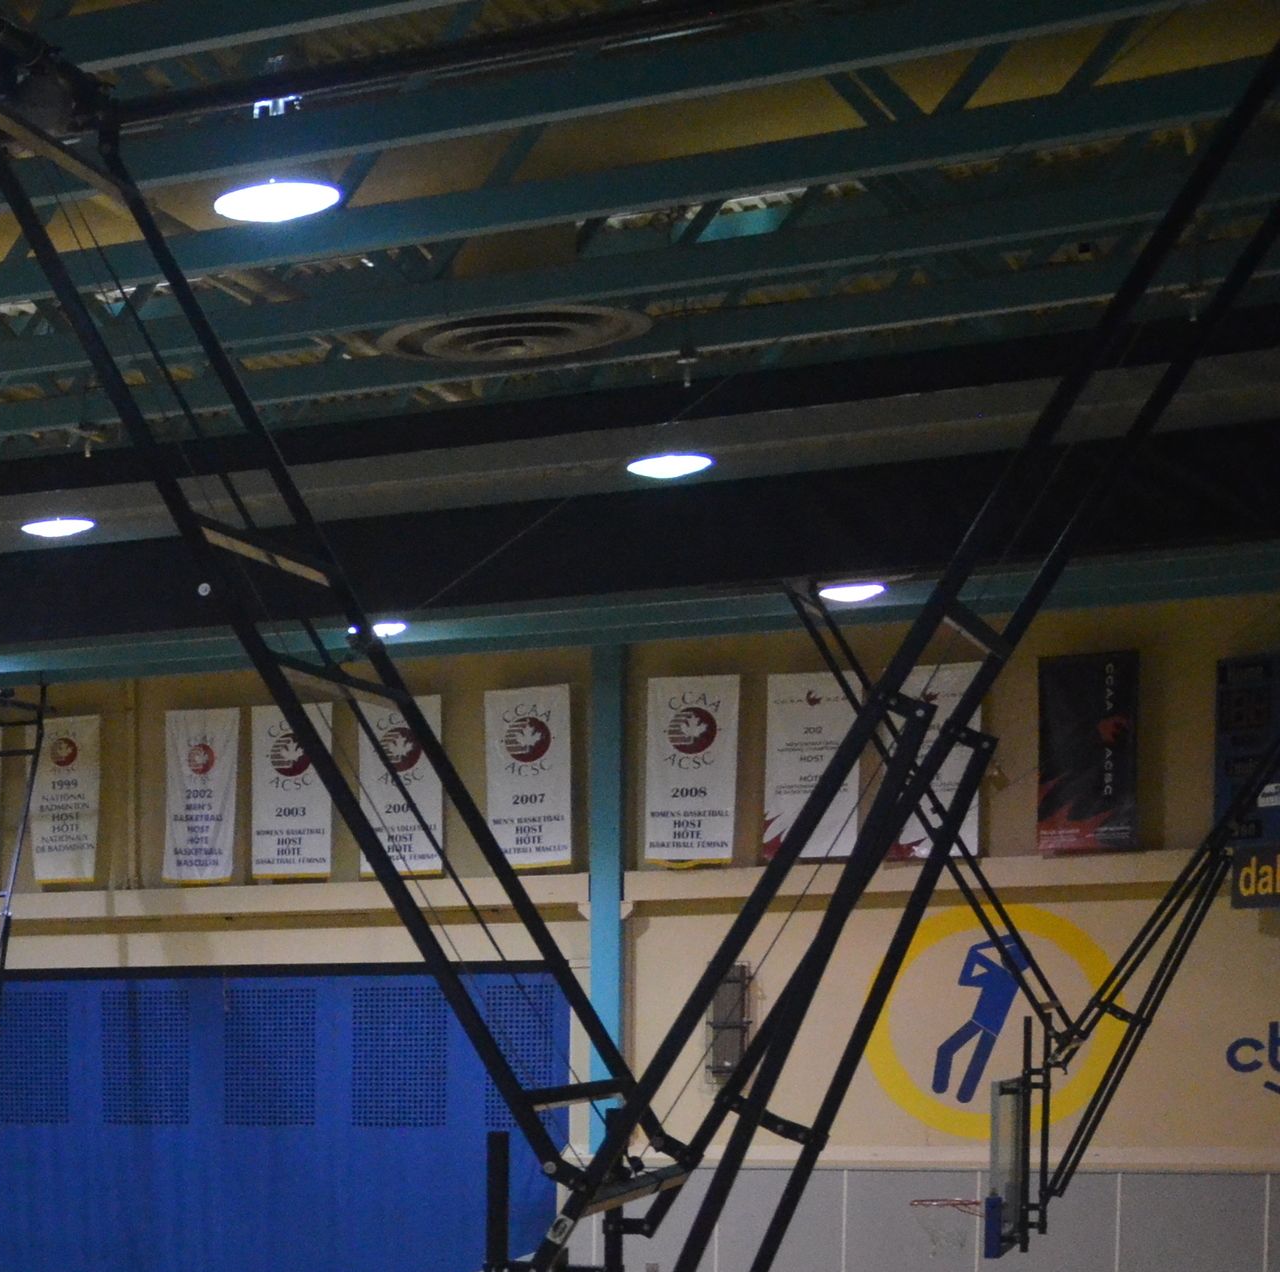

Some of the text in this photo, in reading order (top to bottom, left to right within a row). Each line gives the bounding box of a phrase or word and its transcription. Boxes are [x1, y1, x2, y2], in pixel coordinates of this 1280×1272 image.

[1104, 662, 1115, 711] CCAA
[668, 691, 721, 712] CCAA
[503, 704, 551, 724] CCAA
[665, 752, 715, 770] ACSC
[800, 754, 824, 762] HOST
[504, 759, 553, 777] ACSC
[51, 779, 79, 790] 1999
[270, 773, 312, 792] ACSC
[185, 790, 213, 799] 2002
[671, 787, 708, 798] 2008
[512, 794, 546, 805] 2007
[51, 812, 80, 822] HOST
[275, 806, 307, 818] 2003
[187, 825, 210, 833] HOST
[673, 819, 702, 828] HOST
[515, 825, 542, 835] HOST
[277, 837, 302, 846] HOST
